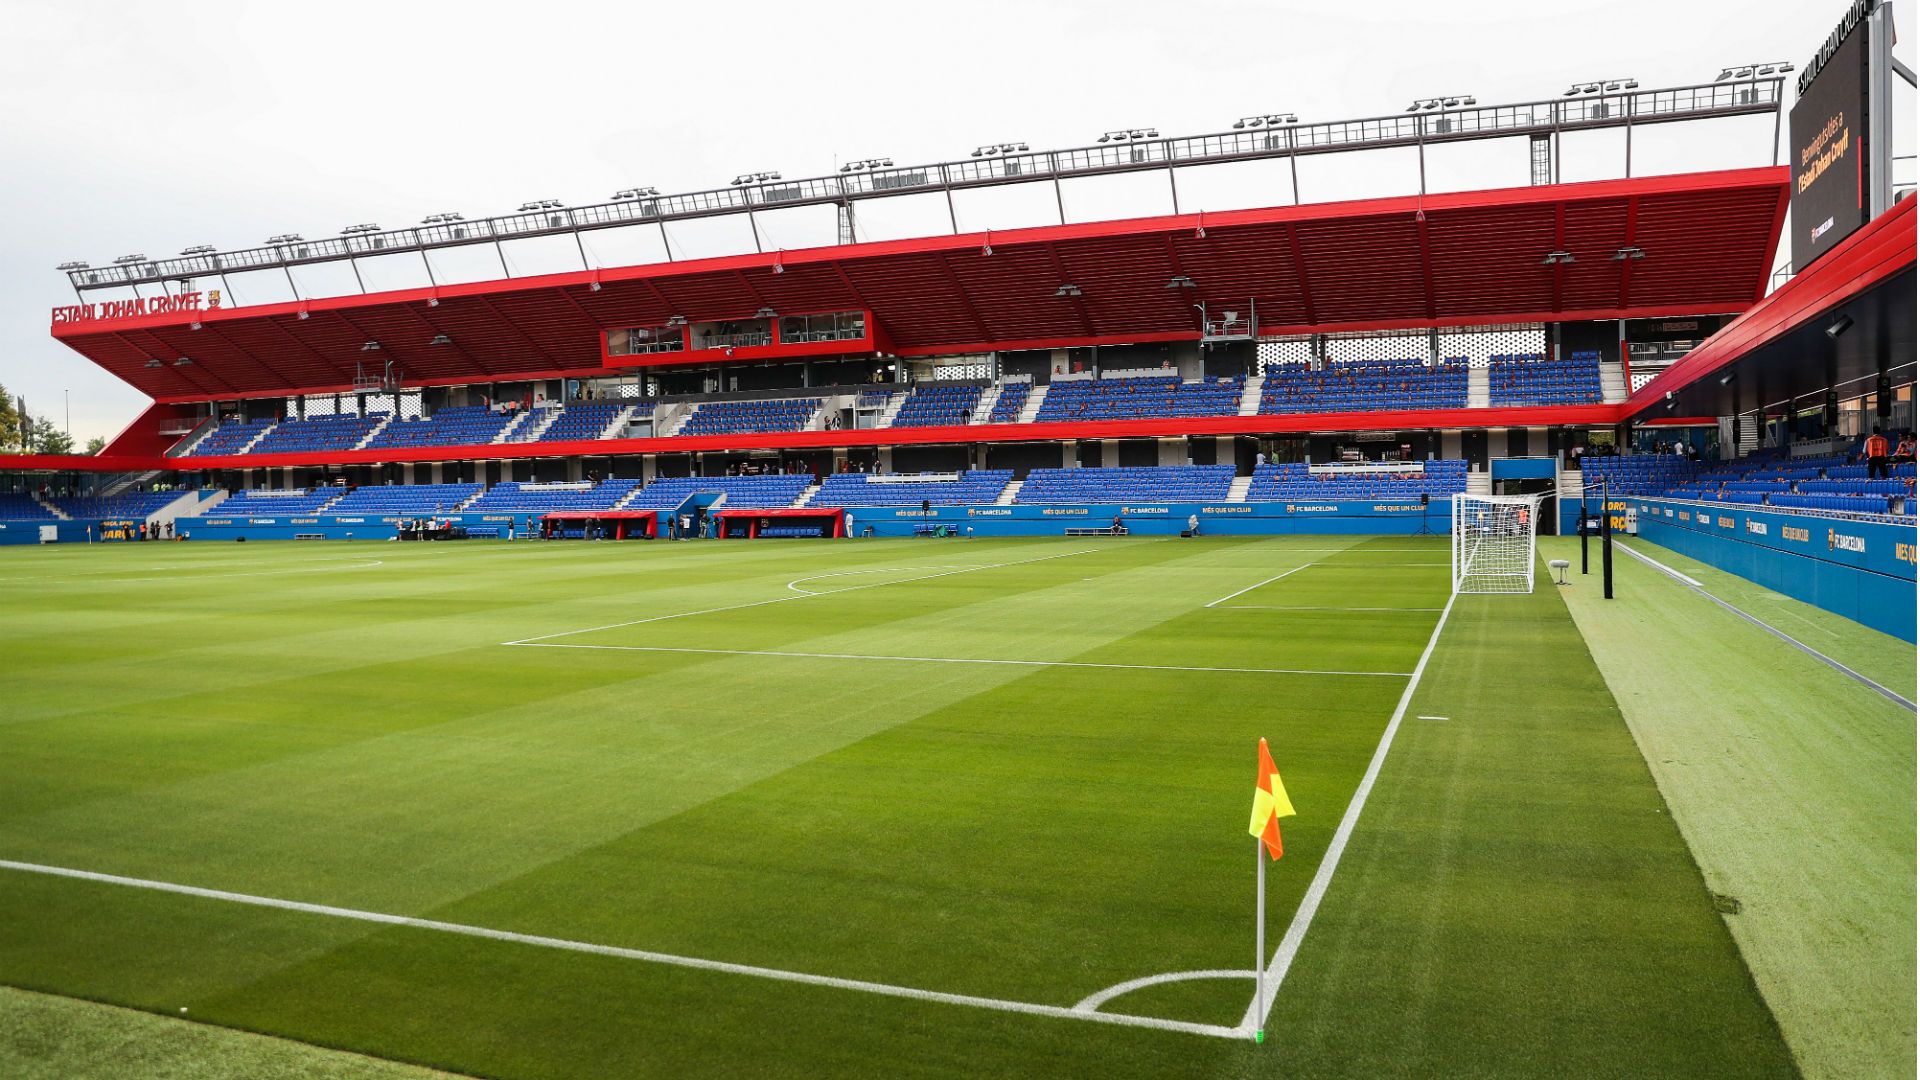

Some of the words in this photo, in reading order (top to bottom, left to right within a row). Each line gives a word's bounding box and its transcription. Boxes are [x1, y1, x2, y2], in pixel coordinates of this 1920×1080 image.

[1798, 58, 1816, 99] ESTADI
[1817, 25, 1840, 73] JOHAN
[1816, 153, 1832, 179] Johan
[1831, 127, 1849, 162] Cruyff
[52, 303, 97, 323] ESTADI
[100, 298, 146, 319] JOHAN
[149, 291, 202, 314] CRUYFF
[1374, 503, 1387, 511] MÉS
[1840, 534, 1866, 553] BARCELONA
